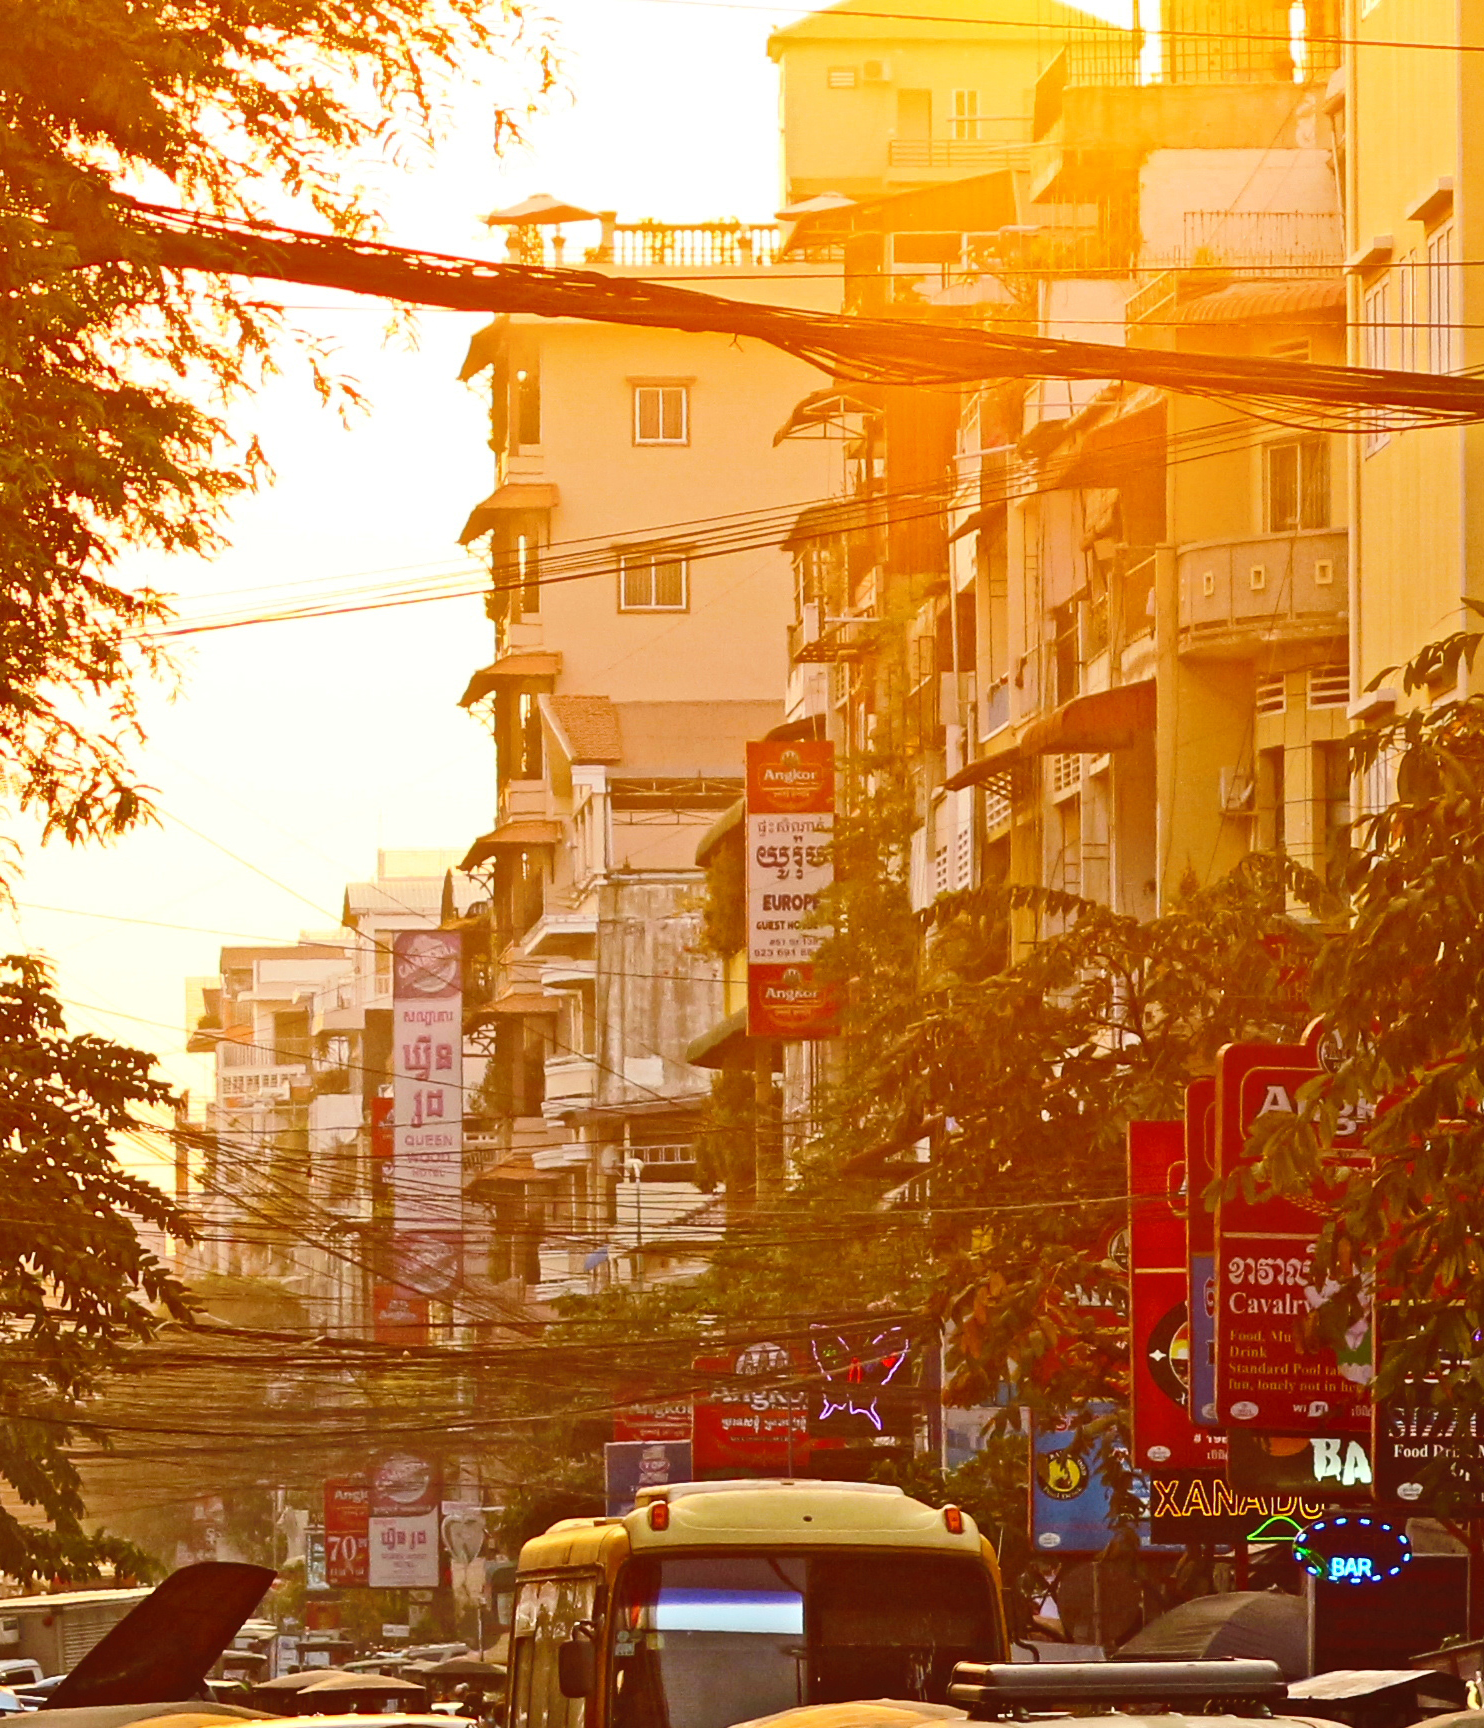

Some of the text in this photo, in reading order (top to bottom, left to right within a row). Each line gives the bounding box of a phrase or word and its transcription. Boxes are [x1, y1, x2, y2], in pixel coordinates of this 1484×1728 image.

[404, 1135, 453, 1147] QUEEN
[1271, 1331, 1292, 1343] Mu
[1229, 1362, 1288, 1375] Standard
[1394, 1444, 1428, 1458] Food
[1330, 1555, 1372, 1578] BAR
